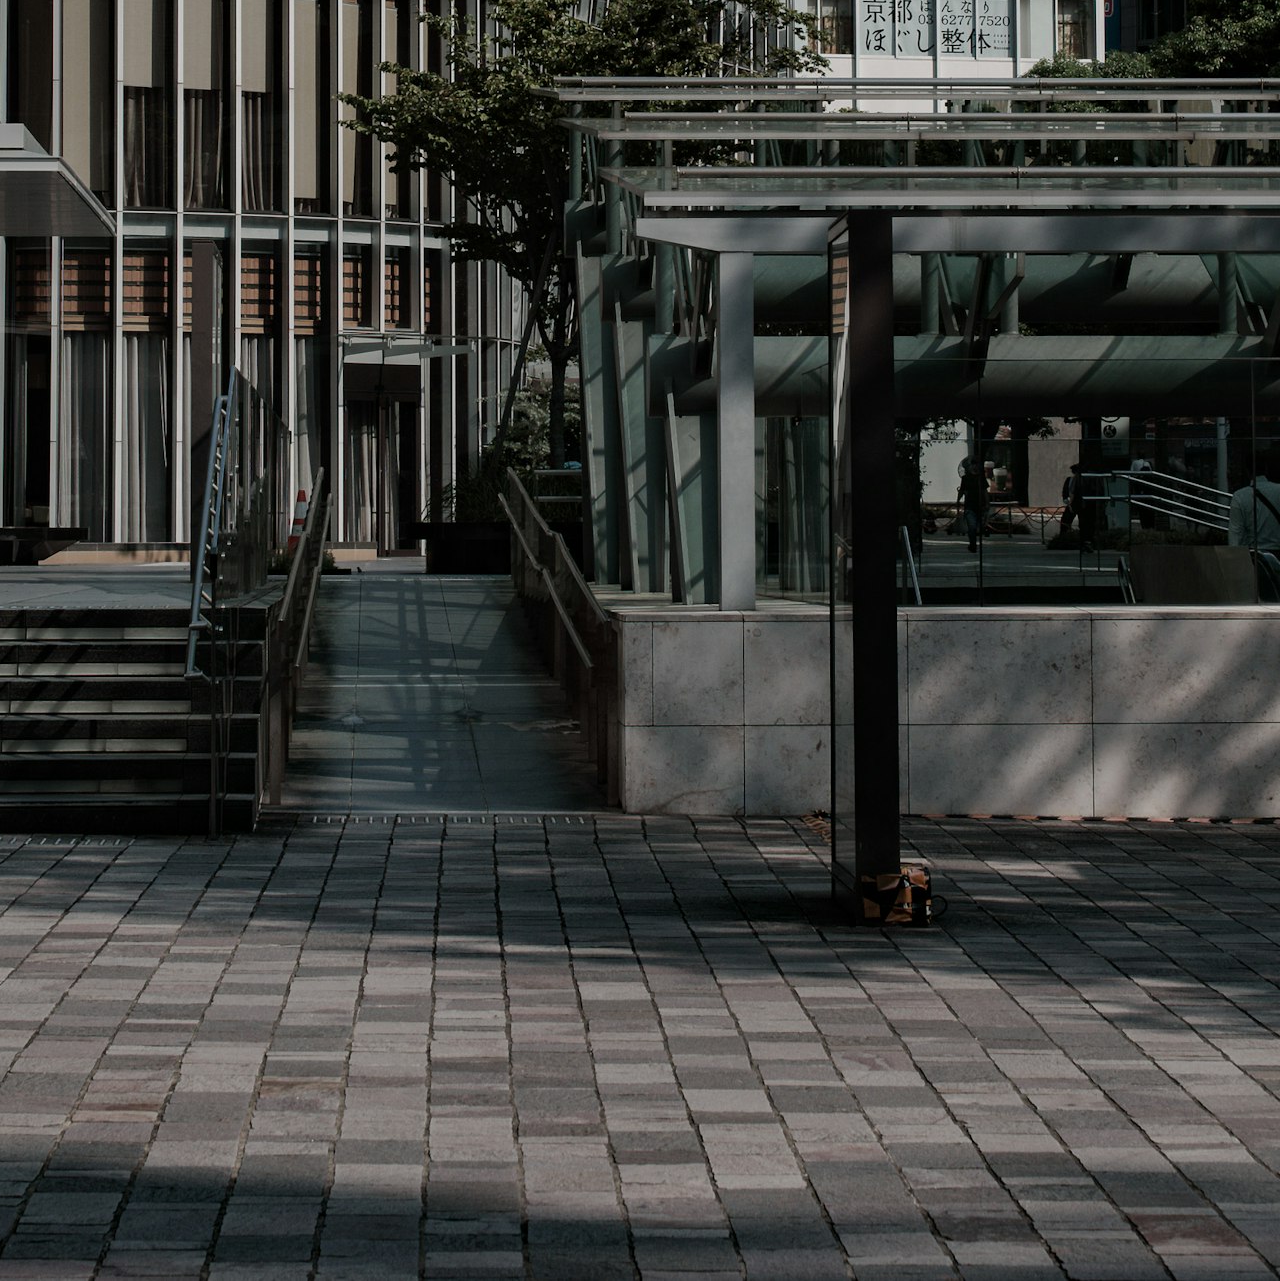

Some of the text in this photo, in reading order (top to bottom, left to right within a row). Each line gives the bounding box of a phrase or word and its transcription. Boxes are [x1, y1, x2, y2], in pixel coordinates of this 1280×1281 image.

[920, 0, 990, 14] はんなり
[918, 15, 1011, 26] 03 6277 7520
